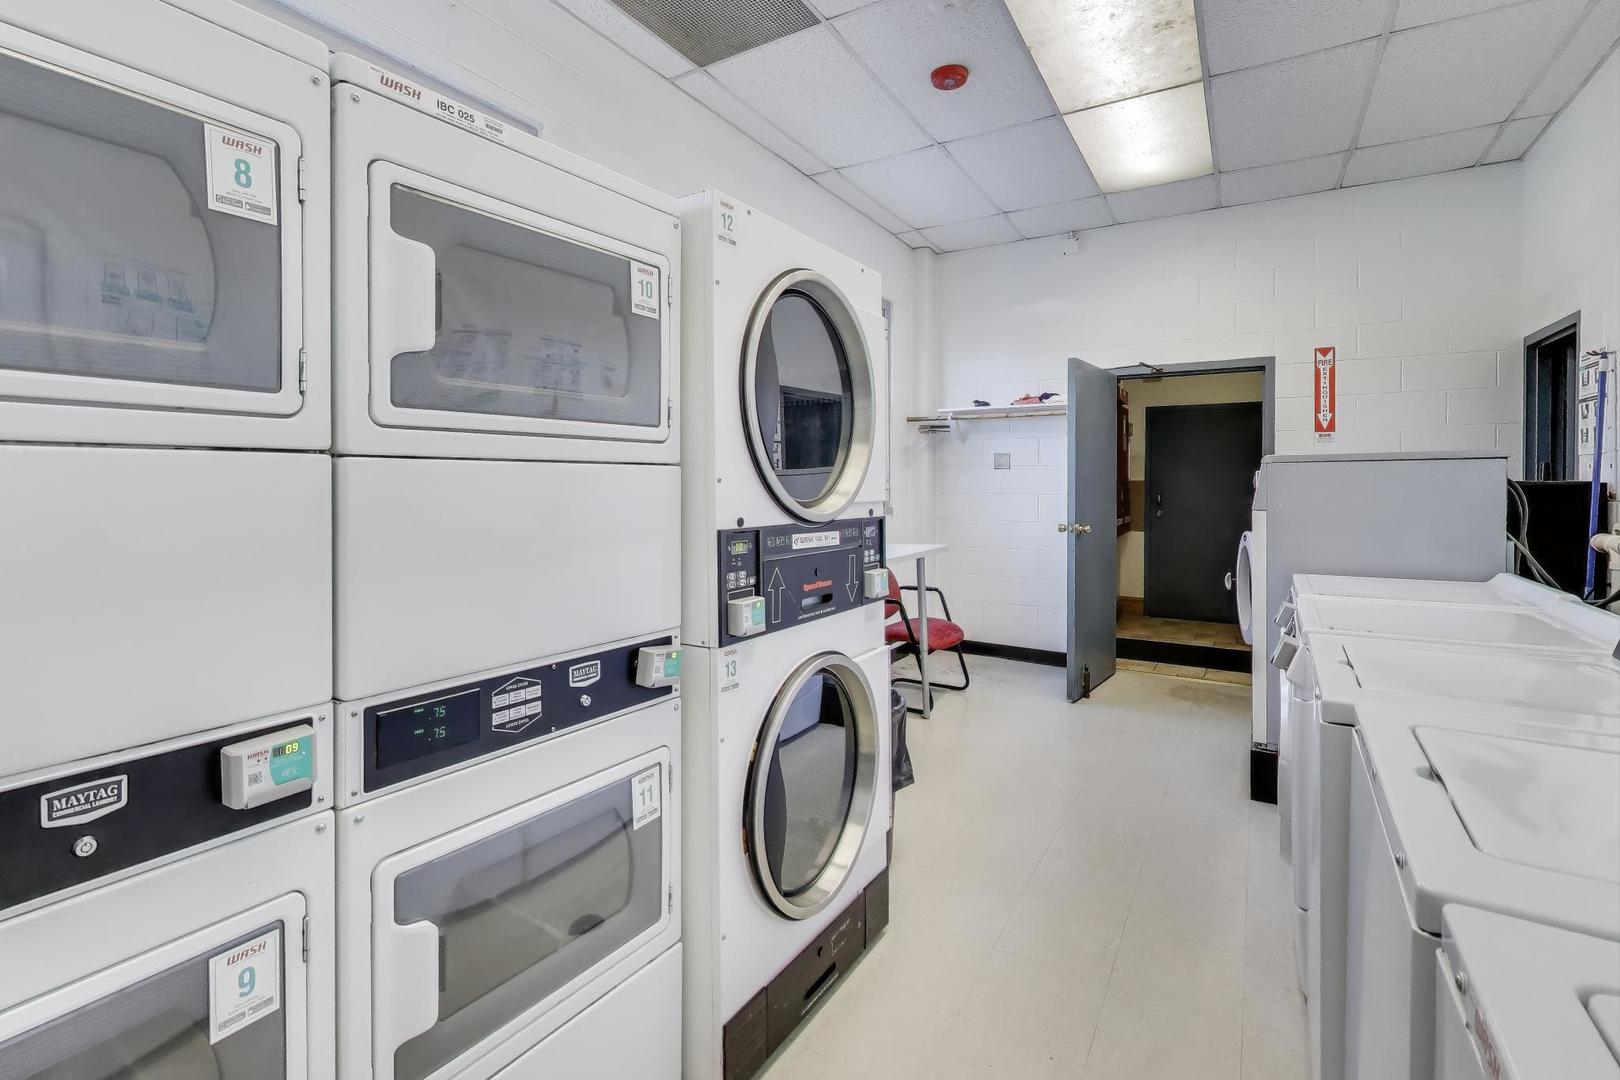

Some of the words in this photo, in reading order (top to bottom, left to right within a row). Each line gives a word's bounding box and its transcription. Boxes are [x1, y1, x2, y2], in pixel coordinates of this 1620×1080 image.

[380, 74, 421, 100] WASH
[436, 99, 455, 114] IBC
[457, 109, 475, 123] 025
[221, 135, 262, 155] WASH
[234, 158, 253, 189] 8
[721, 212, 734, 232] 12
[638, 279, 653, 299] 10
[573, 664, 598, 677] MAYTAG
[724, 660, 737, 679] 13
[52, 784, 118, 811] MAYTAG
[639, 784, 653, 806] 11
[227, 940, 267, 966] WASH
[237, 966, 256, 998] 9
